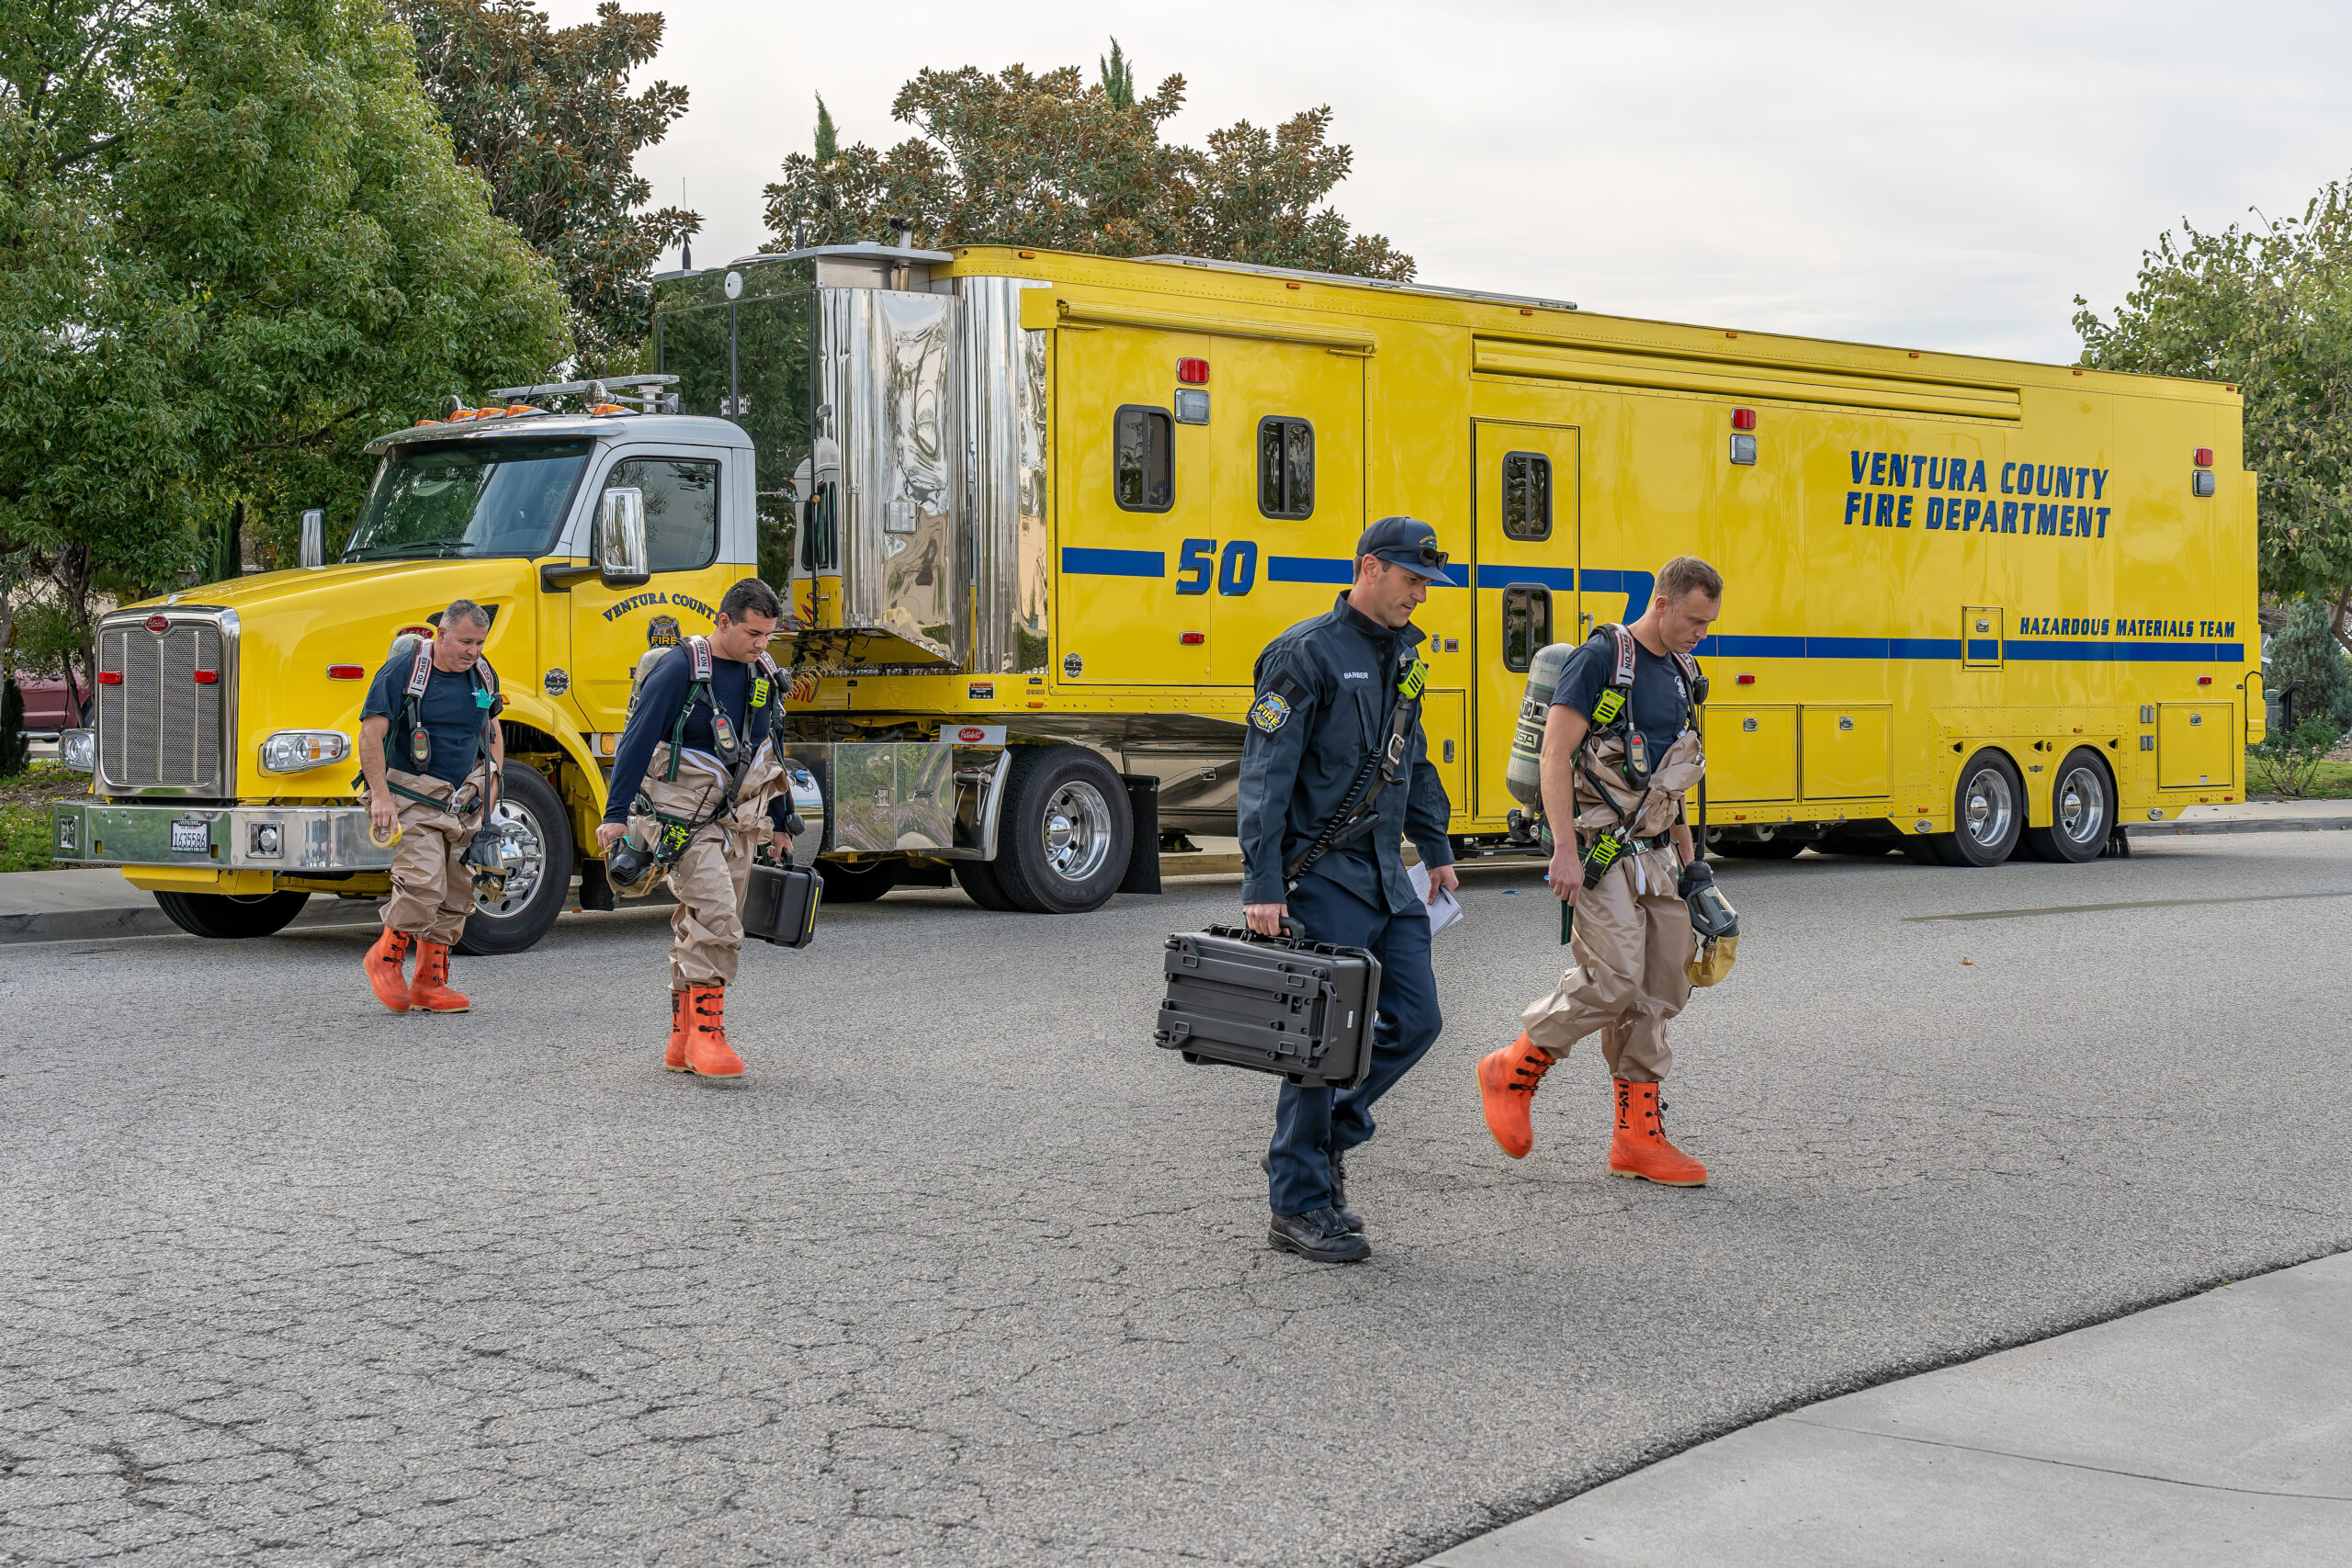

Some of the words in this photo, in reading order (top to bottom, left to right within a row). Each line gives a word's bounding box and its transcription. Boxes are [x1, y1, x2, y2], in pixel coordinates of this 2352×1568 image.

[1850, 451, 1986, 491] VENTURA
[2000, 462, 2109, 500] COUNTY
[1844, 491, 1913, 527] FIRE
[1926, 496, 2110, 538] DEPARTMENT
[1176, 538, 1258, 596] 50
[603, 592, 668, 622] VENTURA
[2019, 617, 2109, 636] HAZARDOUS
[2115, 619, 2195, 637] MATERIALS
[2199, 621, 2235, 637] TEAM
[651, 636, 678, 645] FIRE
[419, 657, 428, 673] PASS
[700, 655, 708, 667] NO
[1624, 657, 1632, 670] NO
[416, 673, 424, 685] NO
[1343, 671, 1369, 680] BARBER
[1257, 704, 1280, 727] FIRE
[175, 832, 206, 847] 1635586
